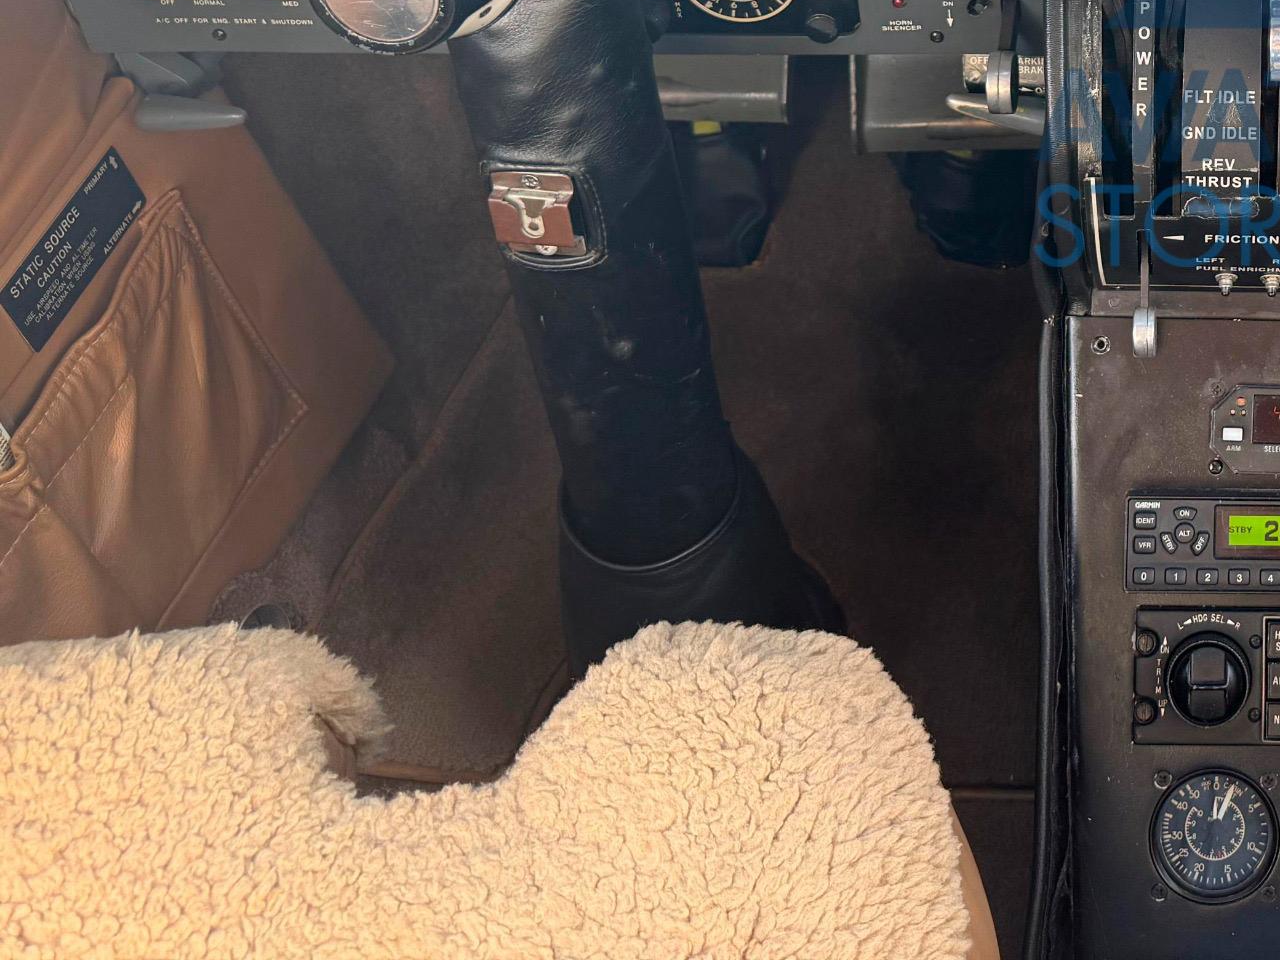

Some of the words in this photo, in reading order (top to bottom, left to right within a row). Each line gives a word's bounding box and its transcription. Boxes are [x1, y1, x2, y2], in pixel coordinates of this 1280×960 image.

[1184, 90, 1213, 103] FLT
[1218, 91, 1256, 103] IDLE
[1182, 127, 1216, 139] GND
[1221, 127, 1257, 140] IDLE
[1202, 159, 1235, 171] REV
[1186, 176, 1252, 188] THRUST
[1205, 235, 1279, 244] FRICTION
[10, 255, 44, 298] STATIC
[44, 206, 80, 253] SOURCE
[37, 242, 73, 288] CAUTION
